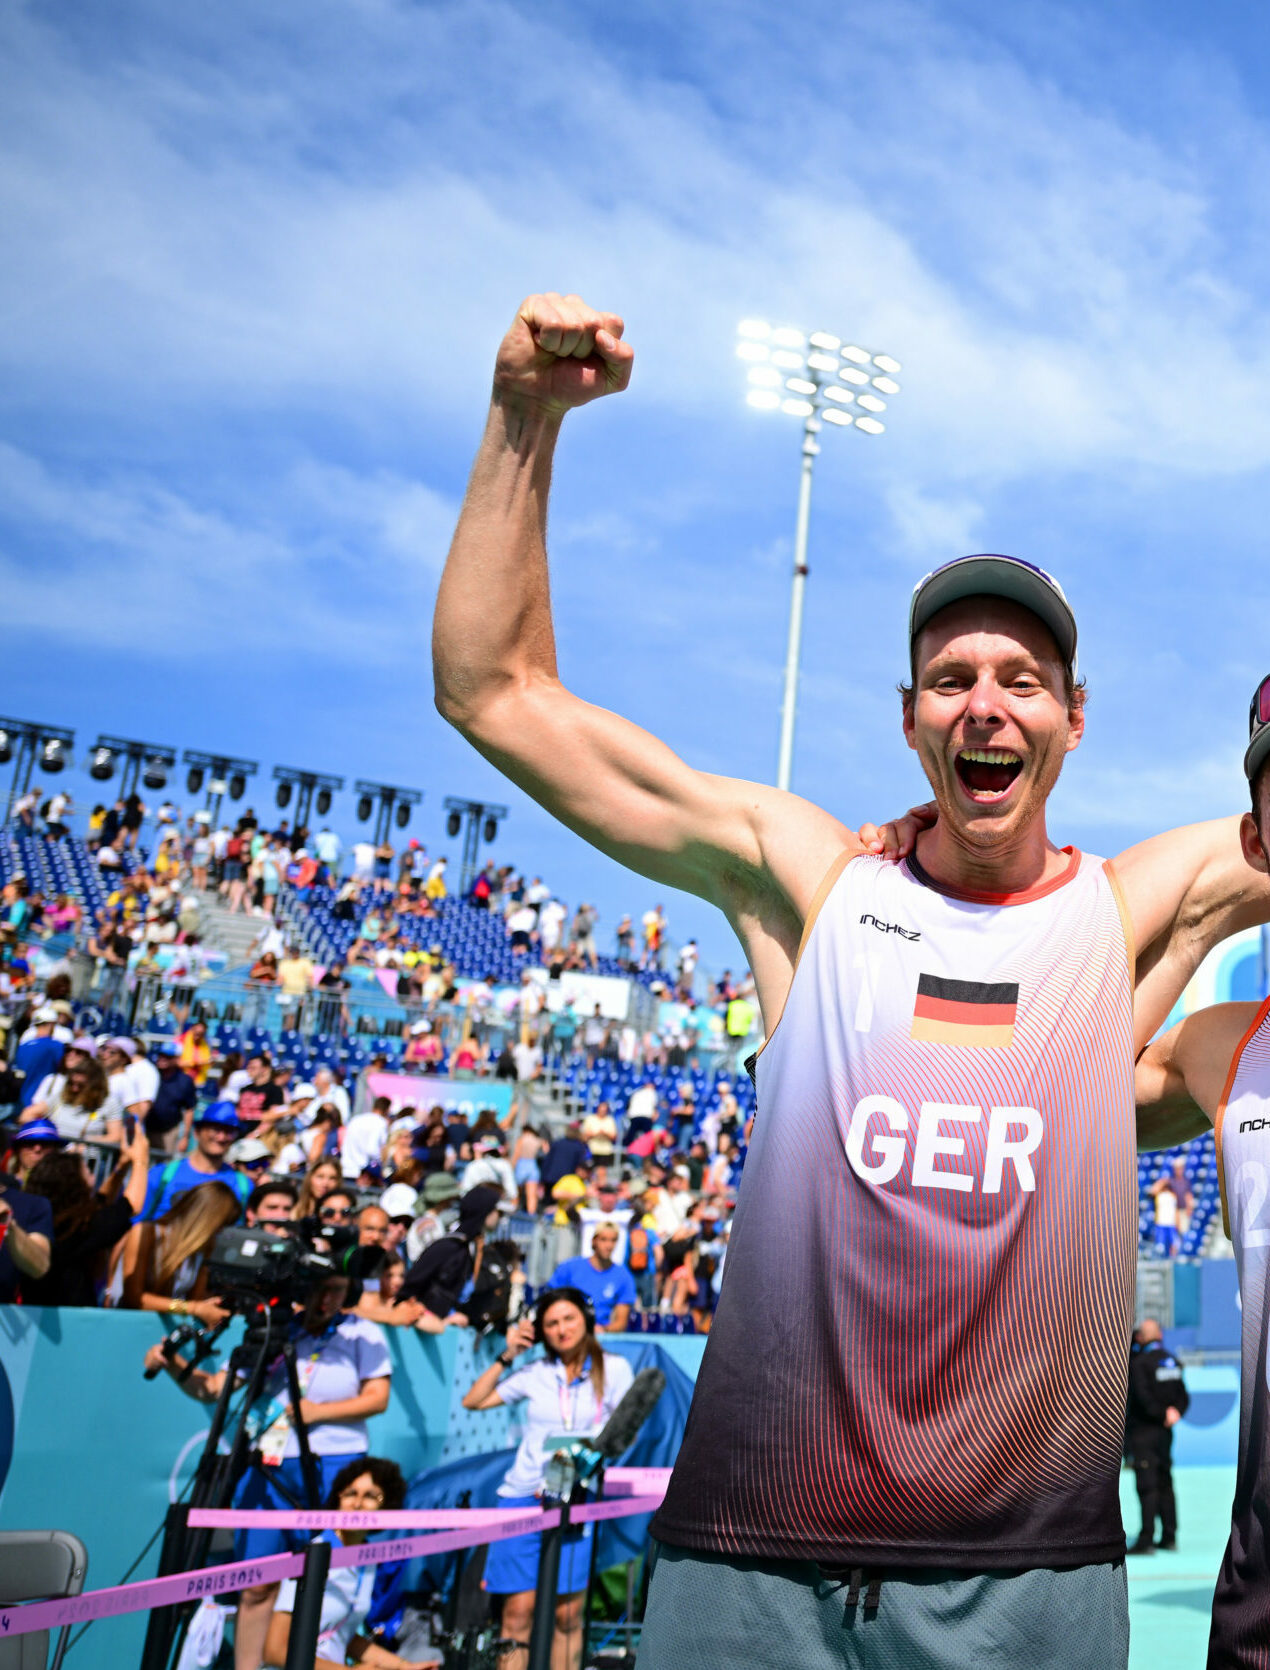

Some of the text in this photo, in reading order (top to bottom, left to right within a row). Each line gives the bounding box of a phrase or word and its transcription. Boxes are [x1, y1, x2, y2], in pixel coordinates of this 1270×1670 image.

[860, 914, 921, 941] INCHEZ
[845, 1095, 1043, 1193] GER
[187, 1568, 263, 1595] PARIS 2024
